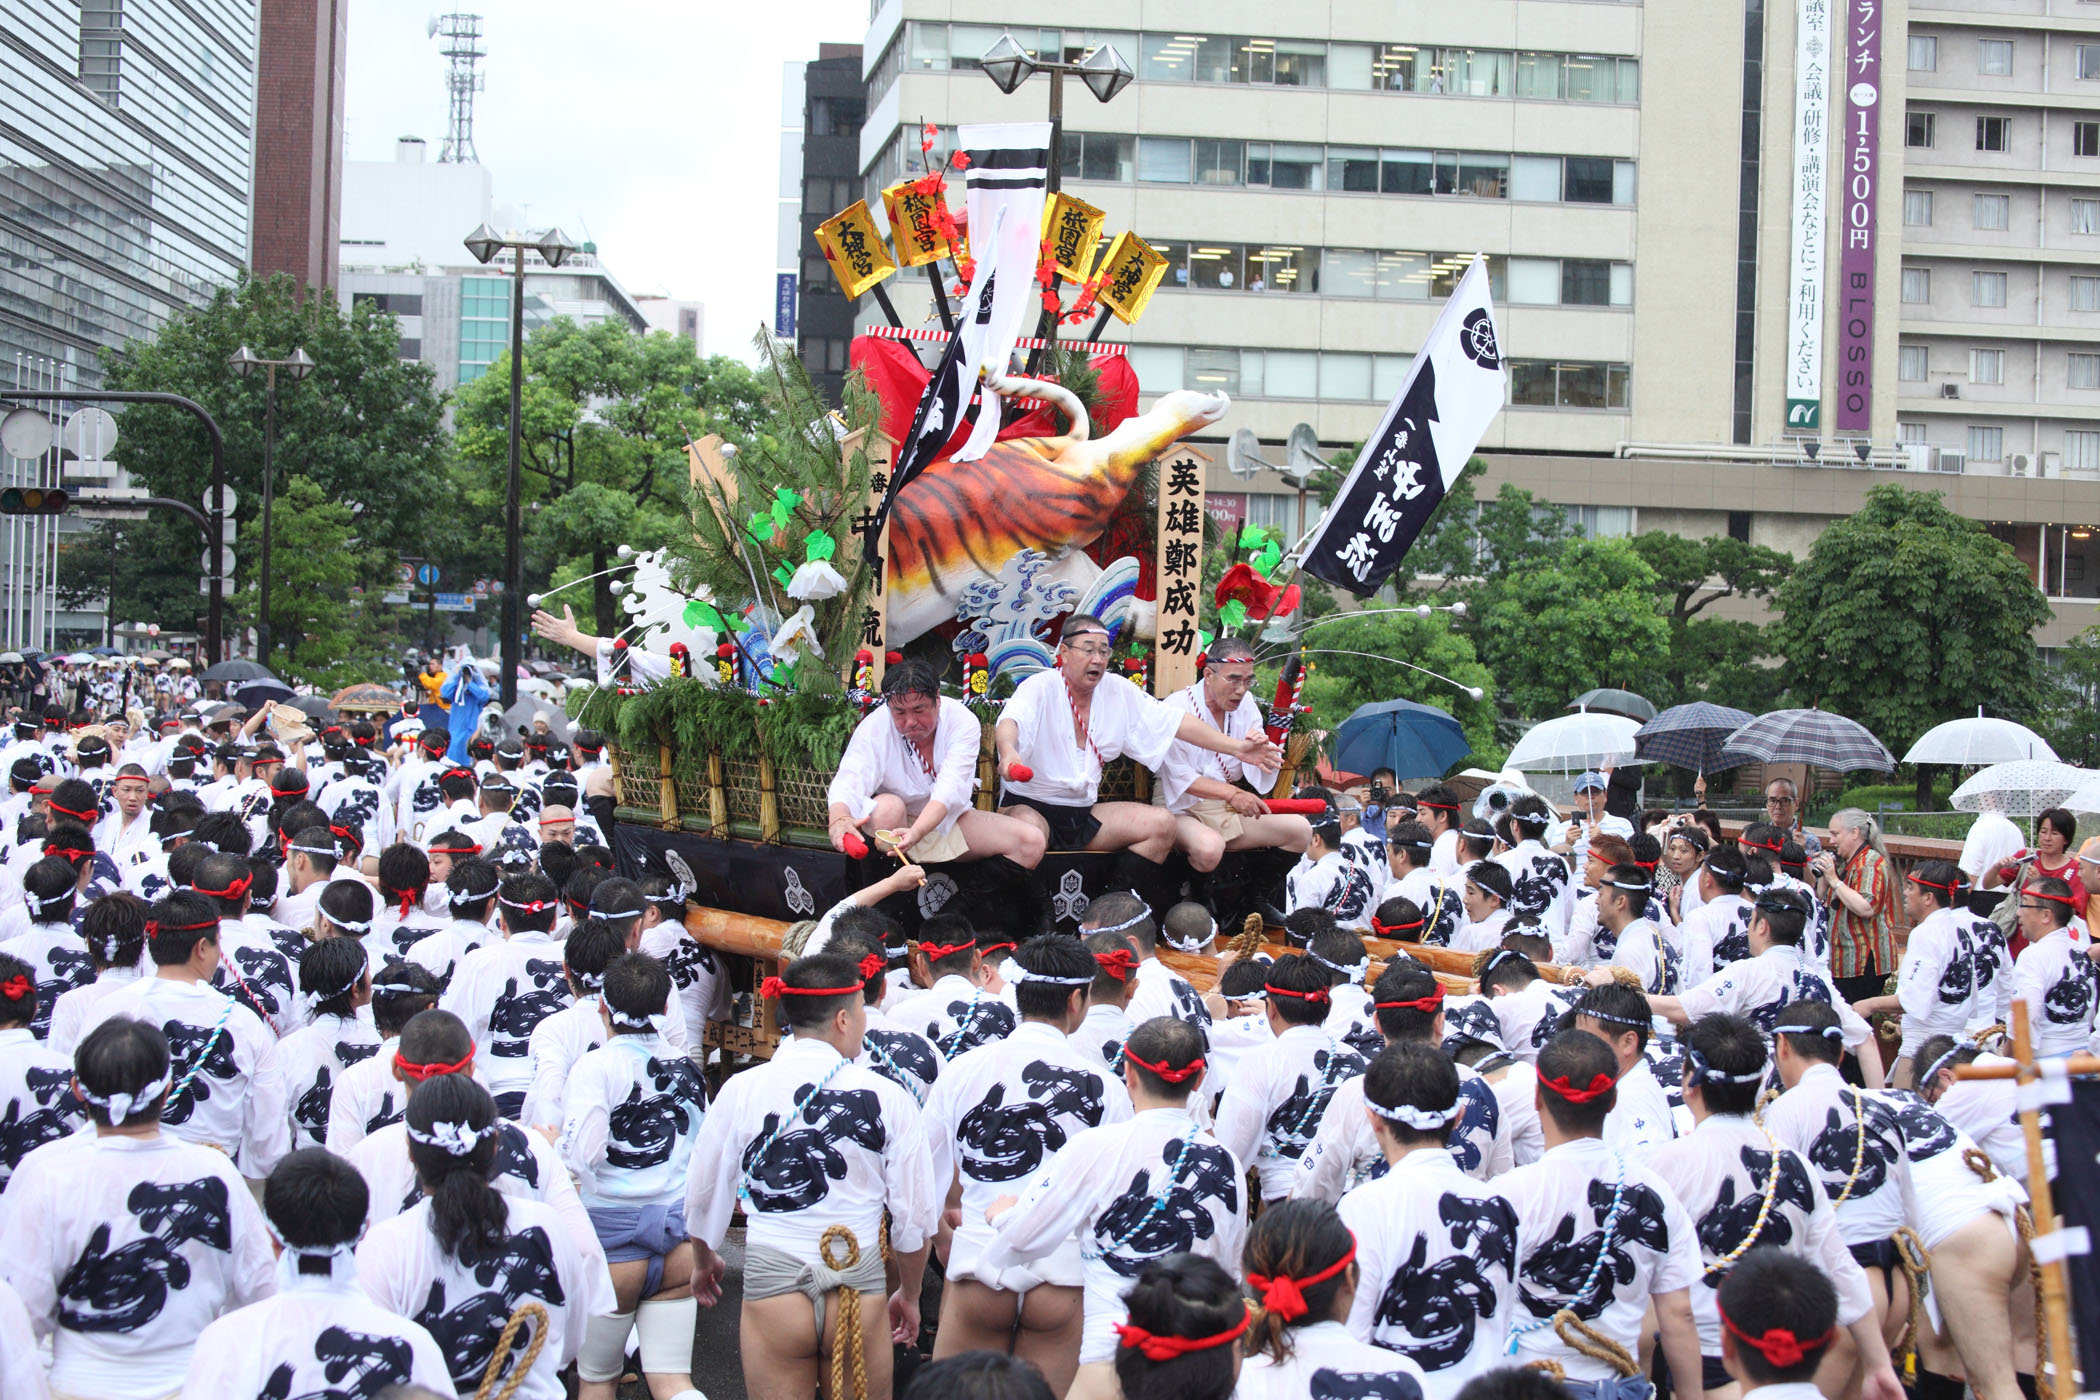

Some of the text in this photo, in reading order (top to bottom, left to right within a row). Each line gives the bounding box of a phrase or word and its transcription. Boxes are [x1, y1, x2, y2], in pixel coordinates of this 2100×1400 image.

[1854, 1, 1876, 75] ランチ
[1850, 110, 1871, 250] 1,500円
[1846, 272, 1868, 413] BLOSSO
[1161, 458, 1200, 656] 英雄鄭成功
